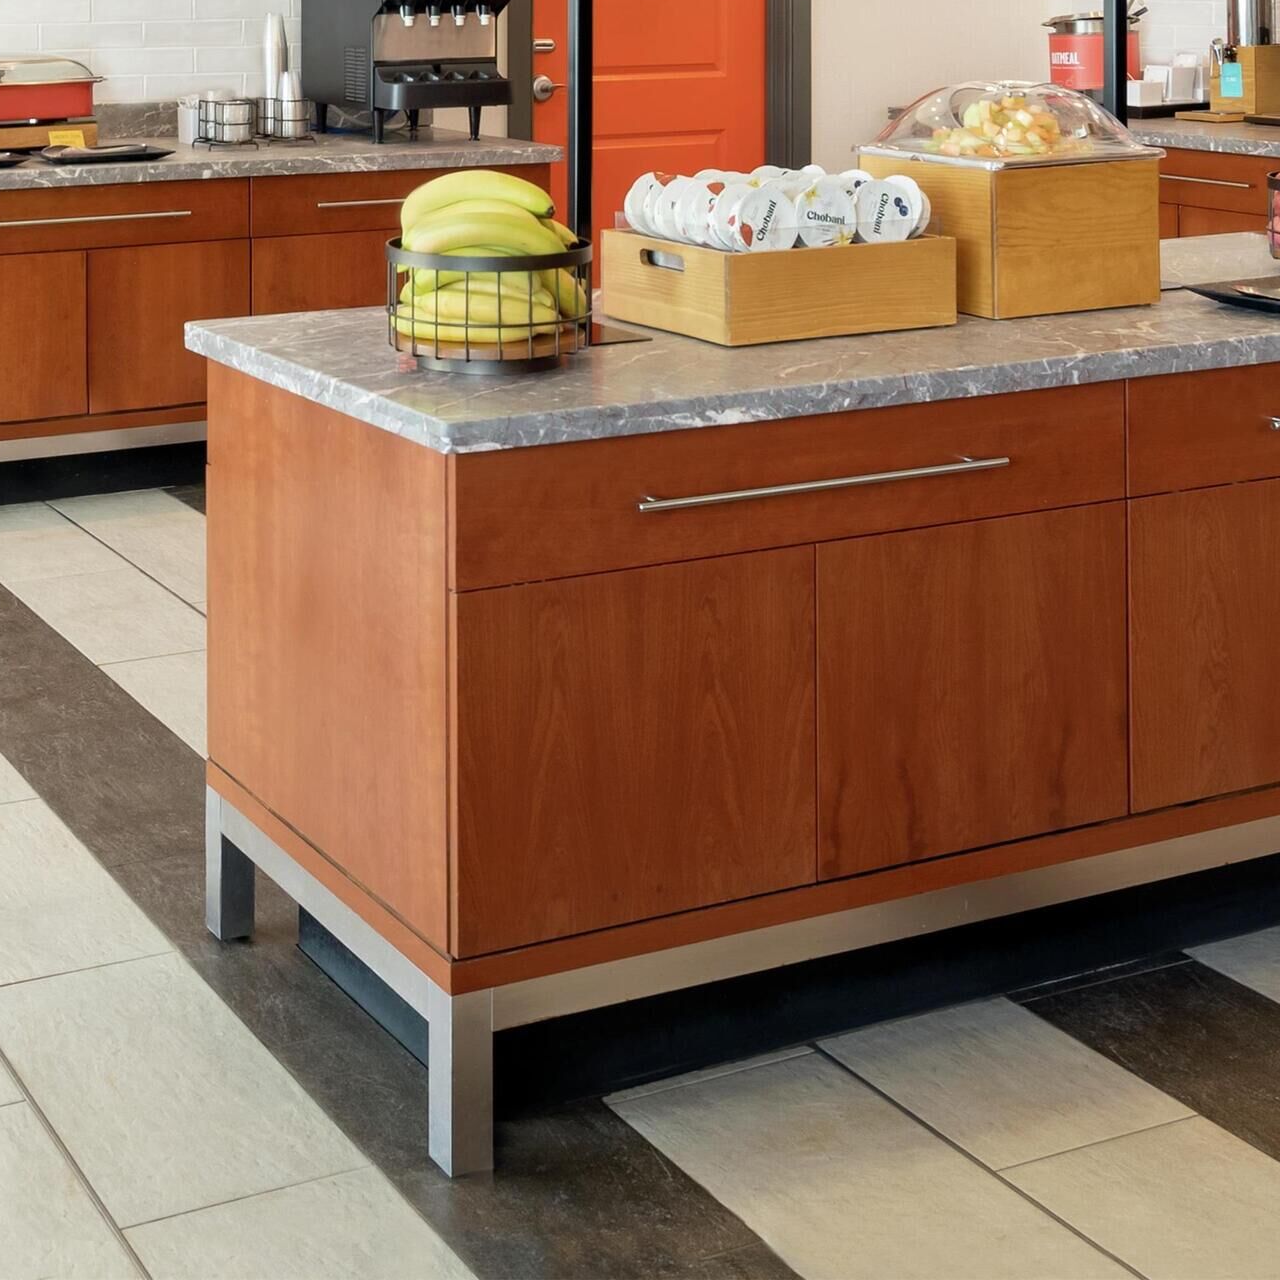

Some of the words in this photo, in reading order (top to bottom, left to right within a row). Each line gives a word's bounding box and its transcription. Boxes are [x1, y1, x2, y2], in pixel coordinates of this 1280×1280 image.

[756, 200, 777, 241] Chobani
[807, 210, 845, 225] Chobani
[873, 193, 889, 235] Chobani
